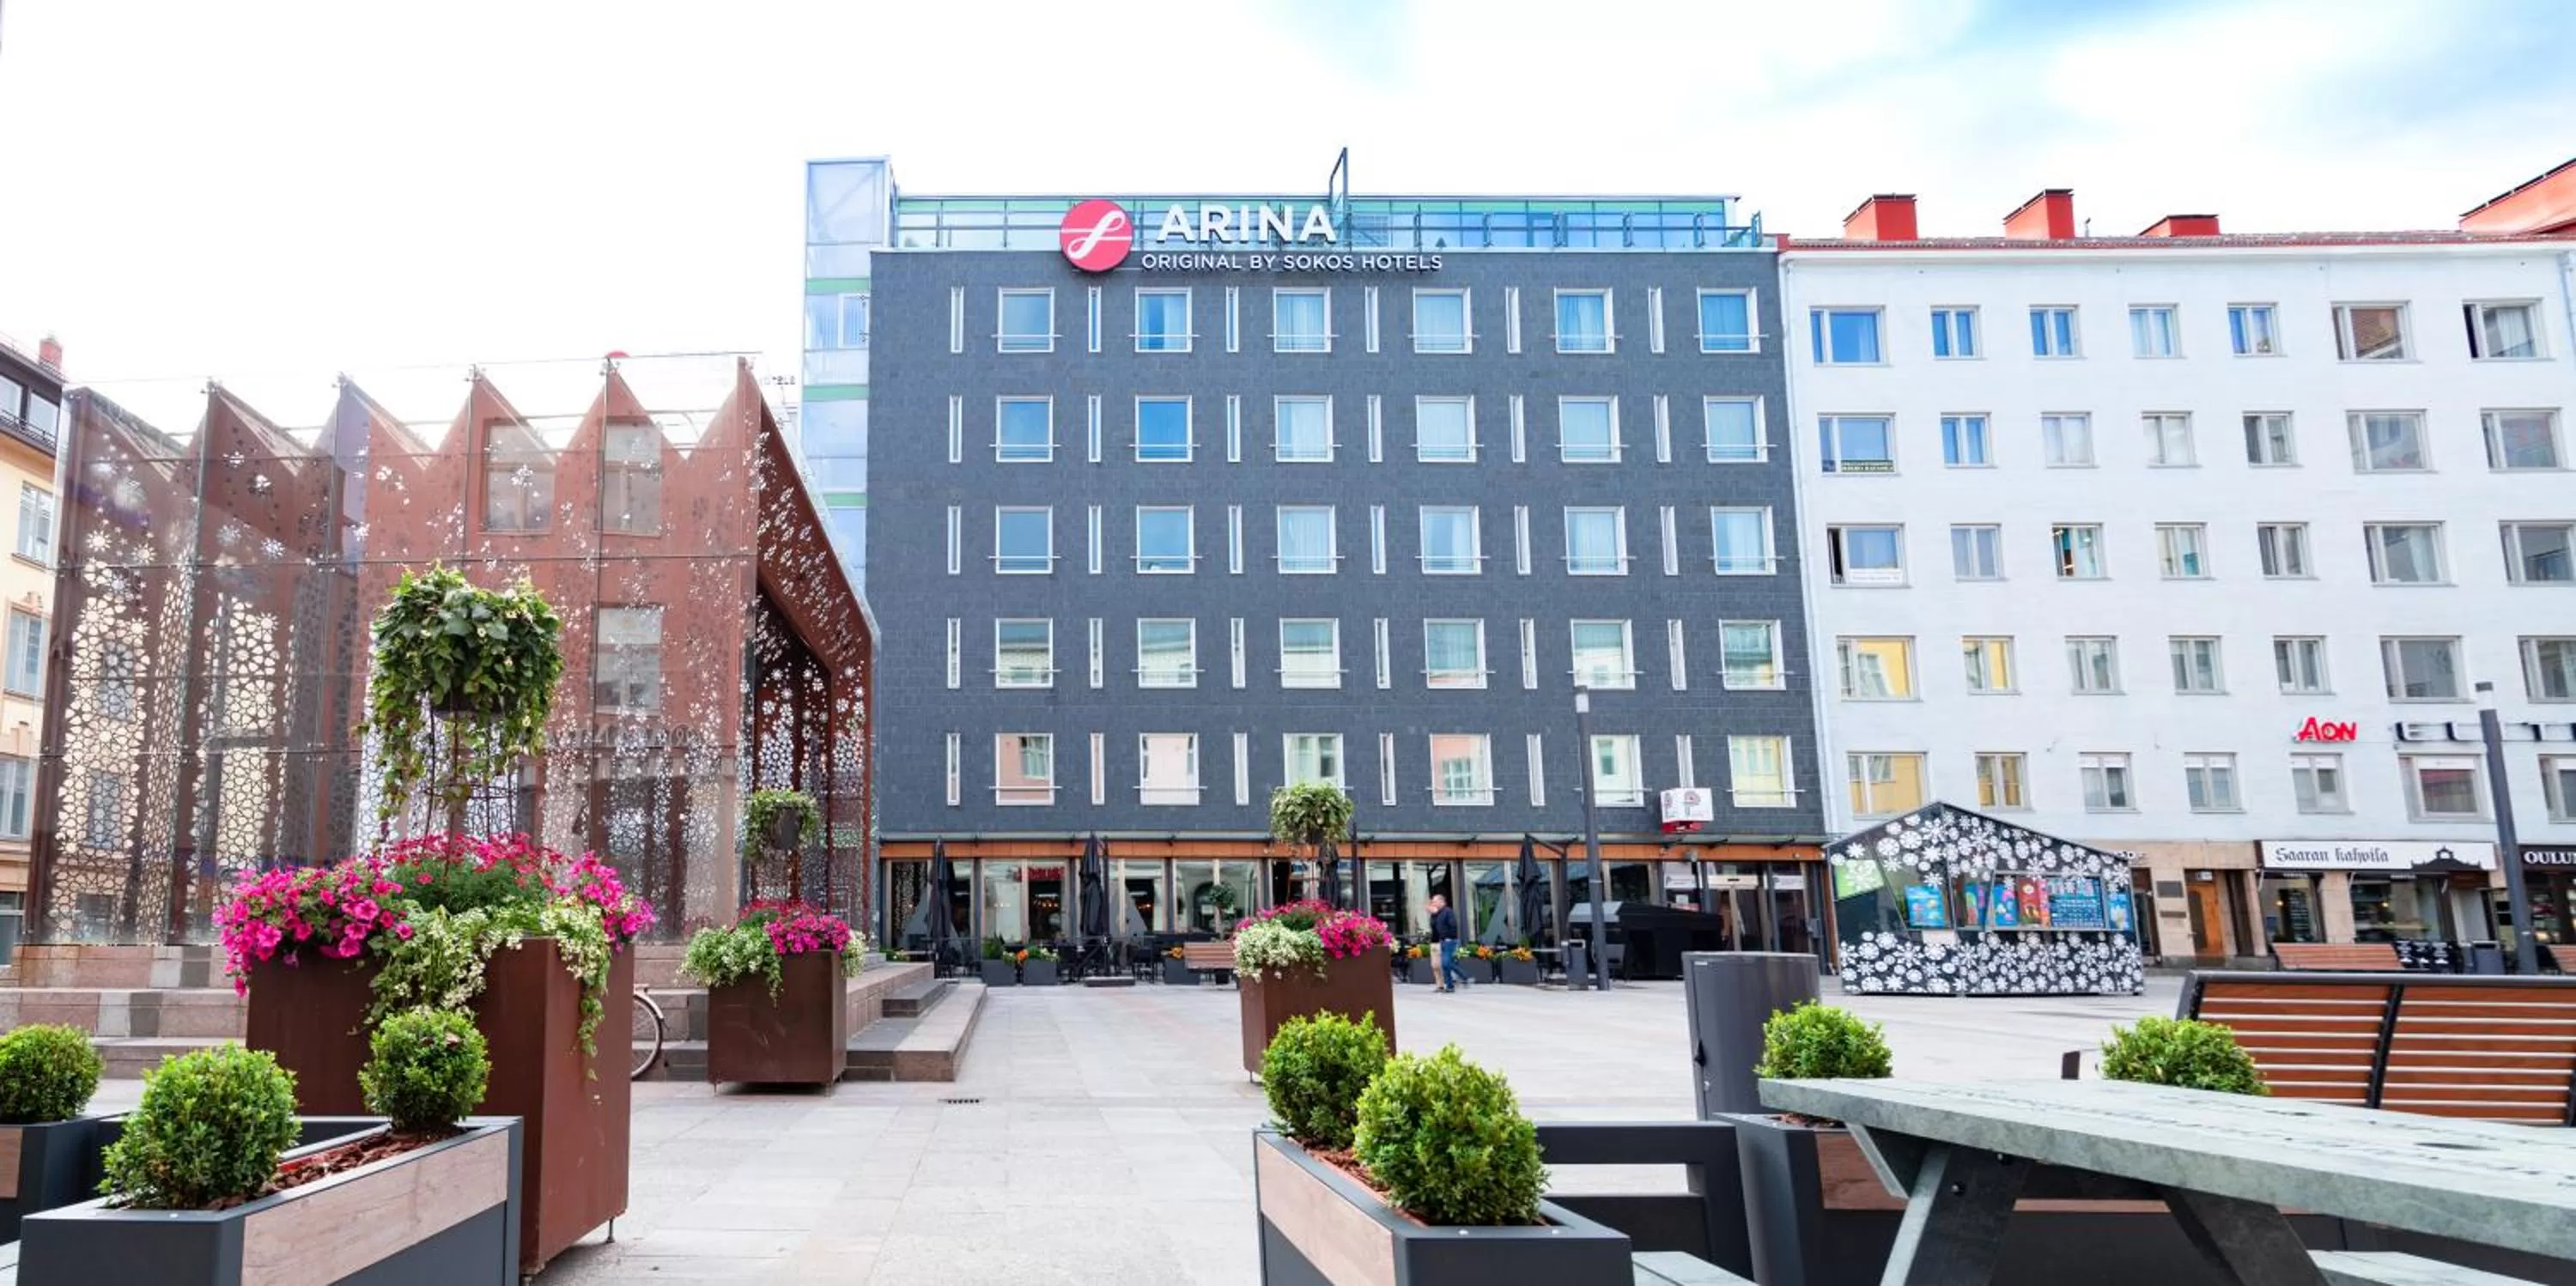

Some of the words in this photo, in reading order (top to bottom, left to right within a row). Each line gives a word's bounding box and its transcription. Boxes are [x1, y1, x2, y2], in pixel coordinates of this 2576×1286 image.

[1156, 203, 1338, 244] ARINA
[1141, 253, 1242, 270] ORIGINAL
[1249, 254, 1279, 270] BY
[1283, 254, 1355, 270] SOKOS
[1362, 255, 1443, 270] HOTELS
[2297, 716, 2358, 742] AON
[2274, 846, 2330, 863] Saaran
[2524, 850, 2576, 865] OULU
